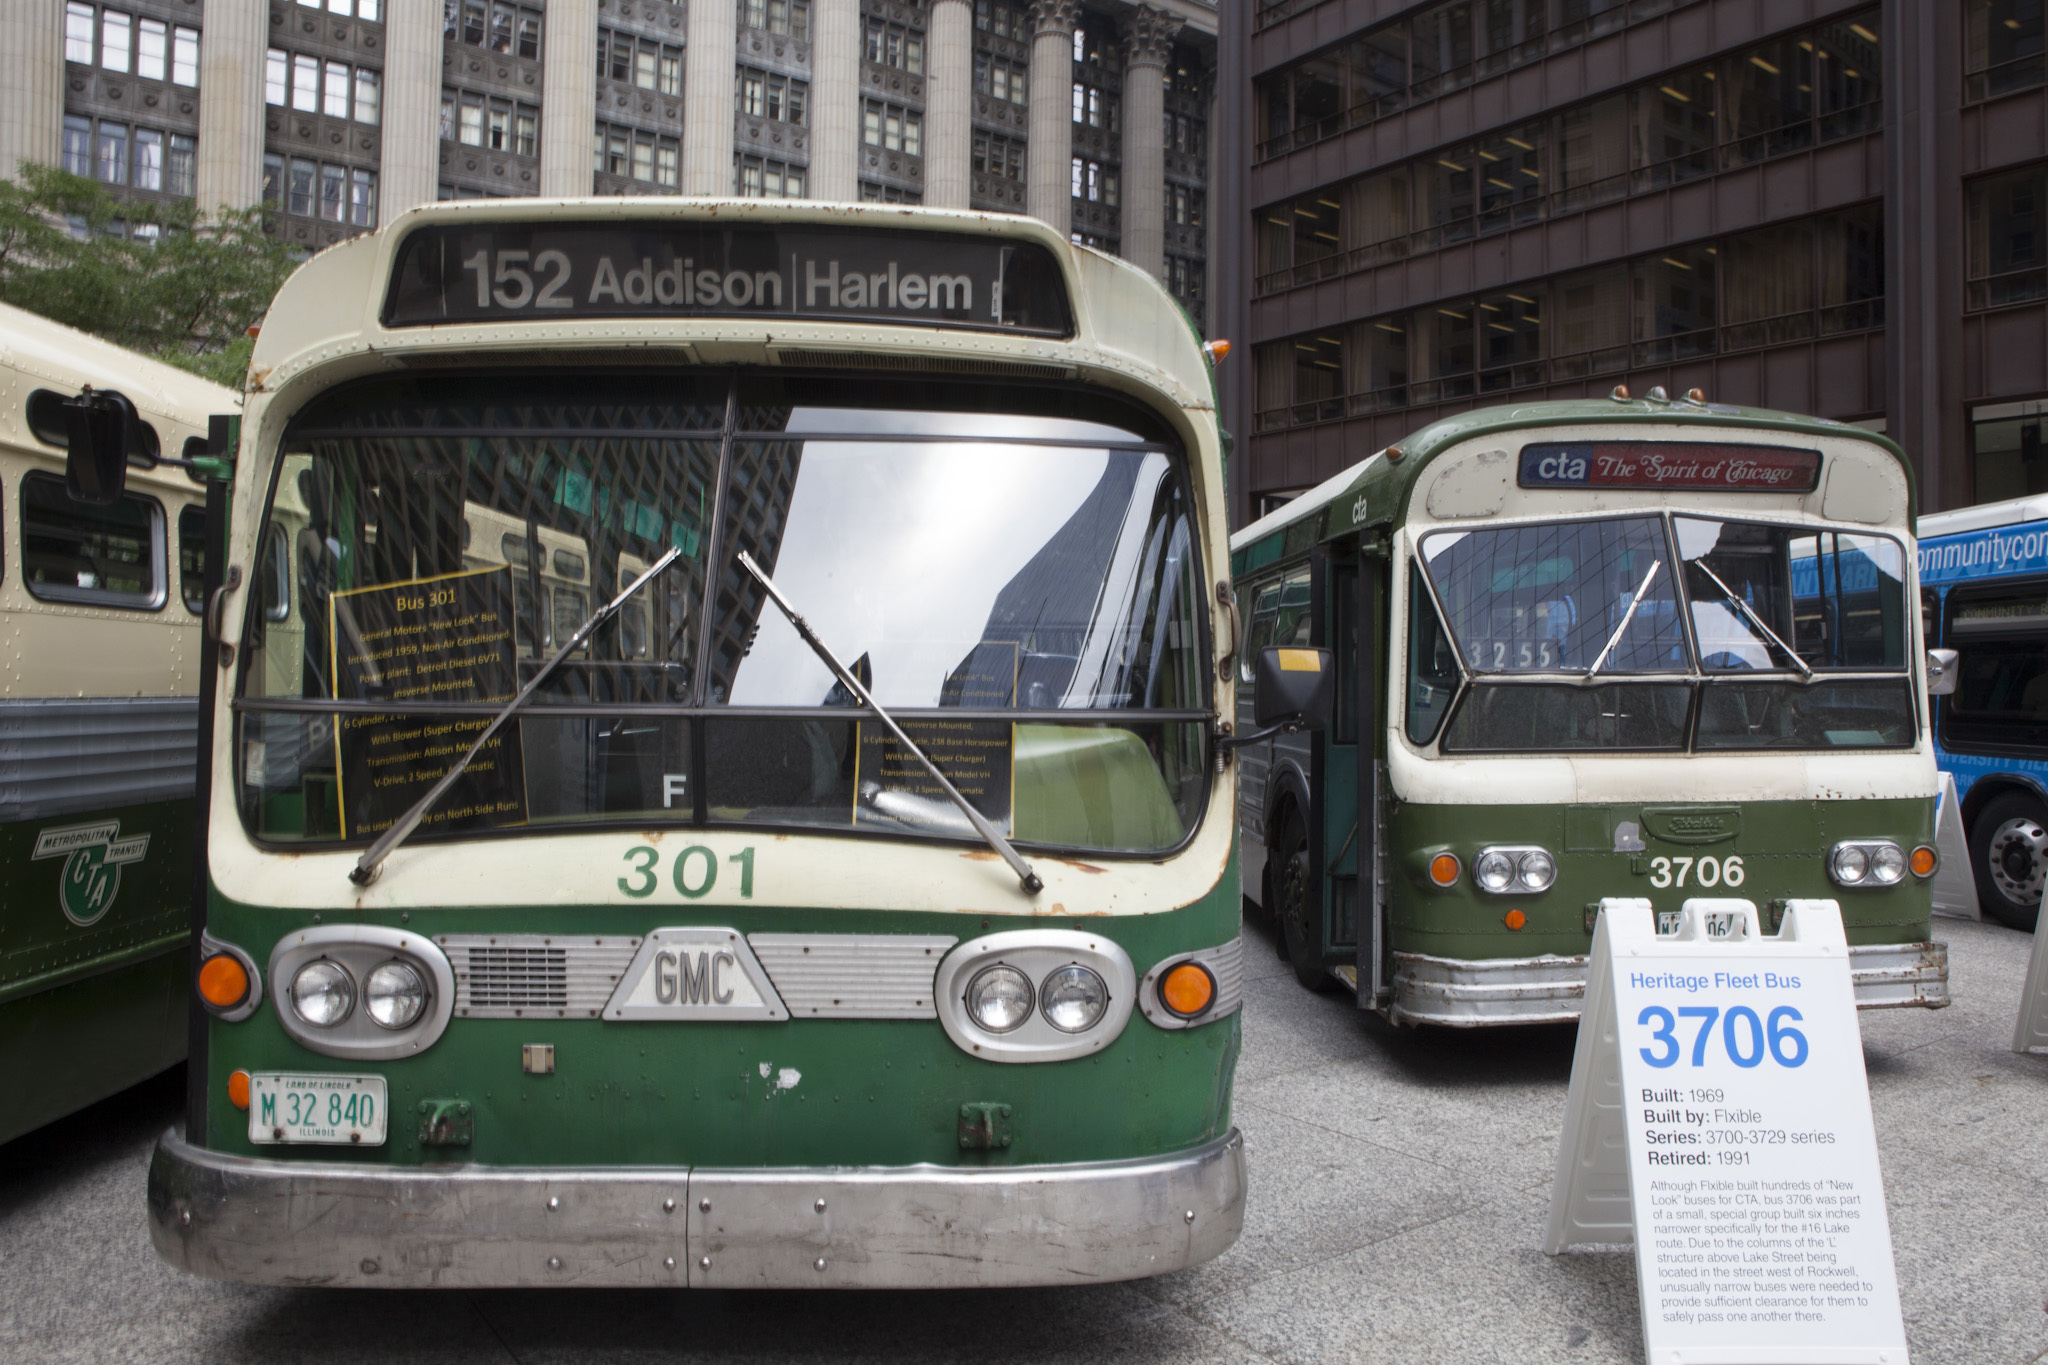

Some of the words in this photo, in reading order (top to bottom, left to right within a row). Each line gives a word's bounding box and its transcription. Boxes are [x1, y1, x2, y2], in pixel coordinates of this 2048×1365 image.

[463, 249, 574, 309] 152
[588, 257, 782, 307] Addison
[806, 260, 971, 311] Harlem
[1538, 452, 1586, 480] cta
[1597, 456, 1636, 477] The
[1640, 455, 1698, 481] Spirit
[1701, 460, 1725, 482] of
[1725, 458, 1793, 483] Chicago
[1352, 494, 1367, 524] cta
[396, 596, 425, 612] Bus
[429, 589, 457, 608] 301
[359, 628, 392, 642] General
[394, 623, 427, 637] Motors
[481, 611, 497, 623] Bus
[348, 650, 393, 665] Introduced
[395, 644, 420, 657] 1959,
[422, 638, 455, 653] Non-Air
[457, 629, 509, 647] Conditioned
[359, 671, 385, 684] Power
[386, 668, 412, 682] plant:
[416, 660, 447, 675] Detroit
[449, 656, 476, 669] Diesel
[477, 652, 500, 666] 6V71
[431, 677, 476, 692] Mounted,
[939, 722, 974, 731] Mounted,
[371, 732, 391, 746] With
[393, 728, 422, 742] Blower
[423, 725, 452, 739] (Super
[931, 738, 945, 746] 238
[946, 738, 962, 746] Base
[964, 739, 1008, 748] Horsepower
[367, 751, 422, 768] Transmission:
[424, 744, 454, 758] Allison
[487, 737, 501, 748] VH
[885, 753, 902, 761] With
[955, 755, 986, 764] Charger)
[374, 773, 407, 788] V-Drive,
[408, 772, 415, 782] 2
[415, 767, 446, 783] Speed,
[880, 769, 928, 778] Transmission:
[955, 770, 977, 779] Model
[979, 771, 991, 779] VH
[663, 774, 687, 808] F
[356, 823, 371, 835] Bus
[372, 820, 392, 832] used
[434, 812, 446, 822] on
[447, 806, 473, 821] North
[474, 803, 494, 816] Side
[497, 800, 519, 812] Runs
[43, 829, 112, 850] METROPOLITAN
[109, 843, 144, 859] TRANSIT
[73, 849, 108, 909] CTA
[617, 845, 755, 899] 301
[1650, 856, 1745, 888] 3706
[654, 950, 735, 1005] GMC
[1630, 972, 1709, 992] Heritage
[1714, 972, 1760, 989] Fleet
[1764, 973, 1802, 989] Bus
[1637, 1005, 1809, 1069] 3706
[286, 1081, 307, 1089] LAND
[308, 1081, 317, 1089] OF
[319, 1081, 352, 1090] LINCOLN
[1641, 1088, 1684, 1103] Built:
[1689, 1088, 1724, 1103] 1969
[261, 1092, 276, 1126] M
[287, 1092, 317, 1127] 32
[328, 1093, 374, 1128] 840
[1643, 1109, 1682, 1124] Built
[1685, 1109, 1710, 1127] by:
[1714, 1109, 1762, 1124] Flxible
[299, 1127, 336, 1137] ILLINOIS
[1645, 1129, 1702, 1145] Series:
[1706, 1129, 1786, 1144] 3700-3729
[1791, 1129, 1836, 1144] series
[1648, 1150, 1712, 1166] Retired:
[1716, 1150, 1751, 1165] 1991
[1650, 1180, 1698, 1193] Although
[1700, 1180, 1734, 1191] Flxible
[1737, 1180, 1759, 1191] built
[1761, 1180, 1811, 1191] hundreds
[1813, 1180, 1824, 1191] of
[1825, 1180, 1854, 1191] “New
[1652, 1194, 1682, 1206] Look”
[1684, 1194, 1717, 1205] buses
[1718, 1194, 1733, 1205] for
[1735, 1194, 1762, 1206] CTA,
[1764, 1194, 1784, 1205] bus
[1786, 1194, 1813, 1205] 3706
[1815, 1196, 1837, 1205] was
[1839, 1195, 1861, 1208] part
[1652, 1209, 1664, 1220] of
[1666, 1211, 1674, 1220] a
[1676, 1209, 1707, 1222] small,
[1710, 1208, 1748, 1222] special
[1750, 1210, 1781, 1223] group
[1783, 1208, 1806, 1220] built
[1808, 1208, 1823, 1219] six
[1825, 1208, 1861, 1219] inches
[1654, 1225, 1701, 1235] narrower
[1704, 1223, 1762, 1237] specifically
[1764, 1223, 1779, 1234] for
[1781, 1223, 1799, 1234] the
[1801, 1223, 1821, 1234] #16
[1824, 1222, 1850, 1233] Lake
[1656, 1238, 1686, 1249] route.
[1688, 1237, 1711, 1249] Due
[1713, 1238, 1724, 1249] to
[1726, 1237, 1744, 1248] the
[1746, 1237, 1792, 1248] columns
[1794, 1237, 1805, 1248] of
[1807, 1237, 1825, 1248] the
[1657, 1252, 1705, 1263] structure
[1707, 1252, 1740, 1263] above
[1742, 1252, 1769, 1263] Lake
[1771, 1252, 1805, 1263] Street
[1806, 1252, 1837, 1265] being
[1658, 1266, 1698, 1278] located
[1700, 1266, 1711, 1277] in
[1712, 1266, 1730, 1277] the
[1733, 1267, 1764, 1277] street
[1765, 1268, 1792, 1277] west
[1794, 1266, 1805, 1277] of
[1807, 1266, 1859, 1278] Rockwell,
[1660, 1281, 1711, 1295] unusually
[1714, 1283, 1751, 1292] narrow
[1754, 1281, 1787, 1292] buses
[1789, 1283, 1817, 1292] were
[1819, 1281, 1860, 1292] needed
[1862, 1281, 1873, 1292] to
[1661, 1296, 1702, 1309] provide
[1704, 1296, 1753, 1307] sufficient
[1755, 1296, 1808, 1307] clearance
[1810, 1296, 1824, 1307] for
[1827, 1296, 1855, 1307] them
[1857, 1296, 1869, 1307] to
[1663, 1311, 1694, 1324] safely
[1697, 1313, 1724, 1324] pass
[1726, 1313, 1748, 1322] one
[1750, 1311, 1792, 1322] another
[1794, 1311, 1826, 1322] there.
